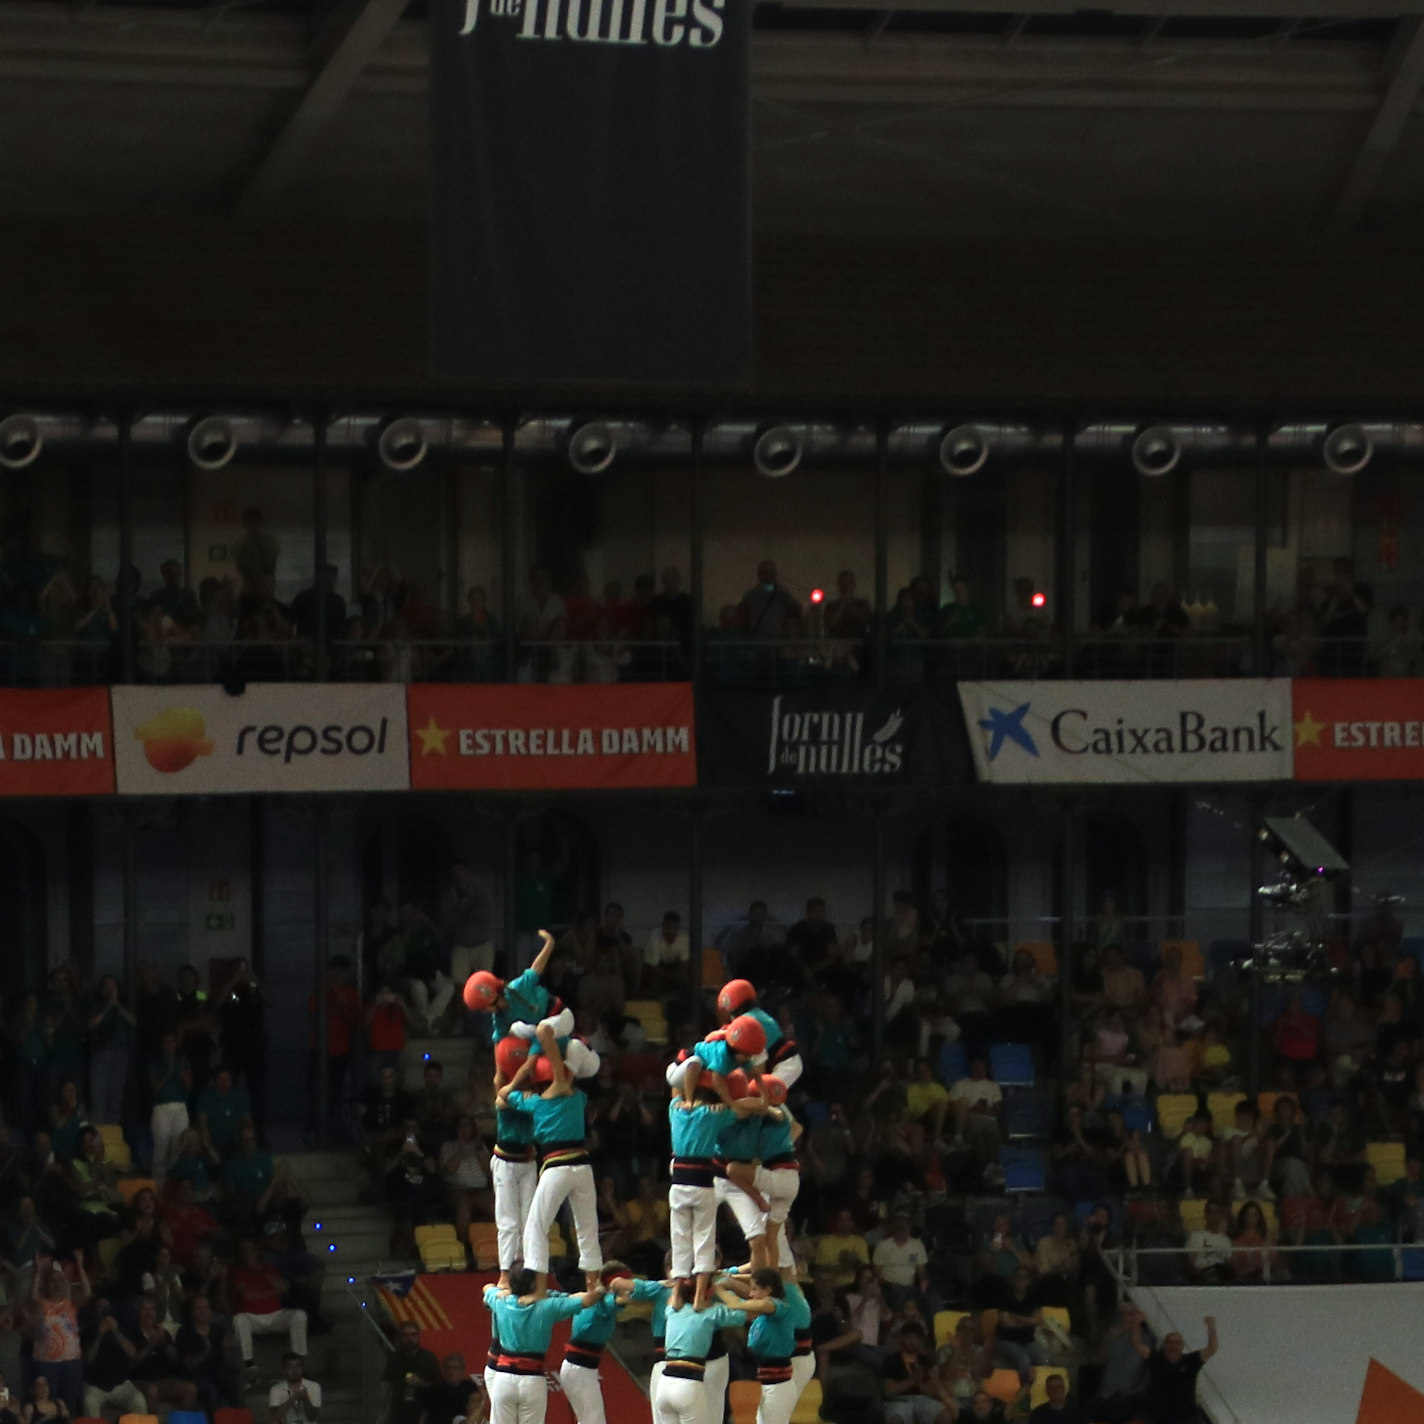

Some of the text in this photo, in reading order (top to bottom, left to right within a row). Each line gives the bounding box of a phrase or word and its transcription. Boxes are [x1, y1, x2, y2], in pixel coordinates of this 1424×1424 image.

[12, 731, 105, 760] DAMM
[236, 716, 387, 759] repsol
[458, 725, 691, 757] ESTRELLA DAMM
[1050, 707, 1284, 757] CaixaBank
